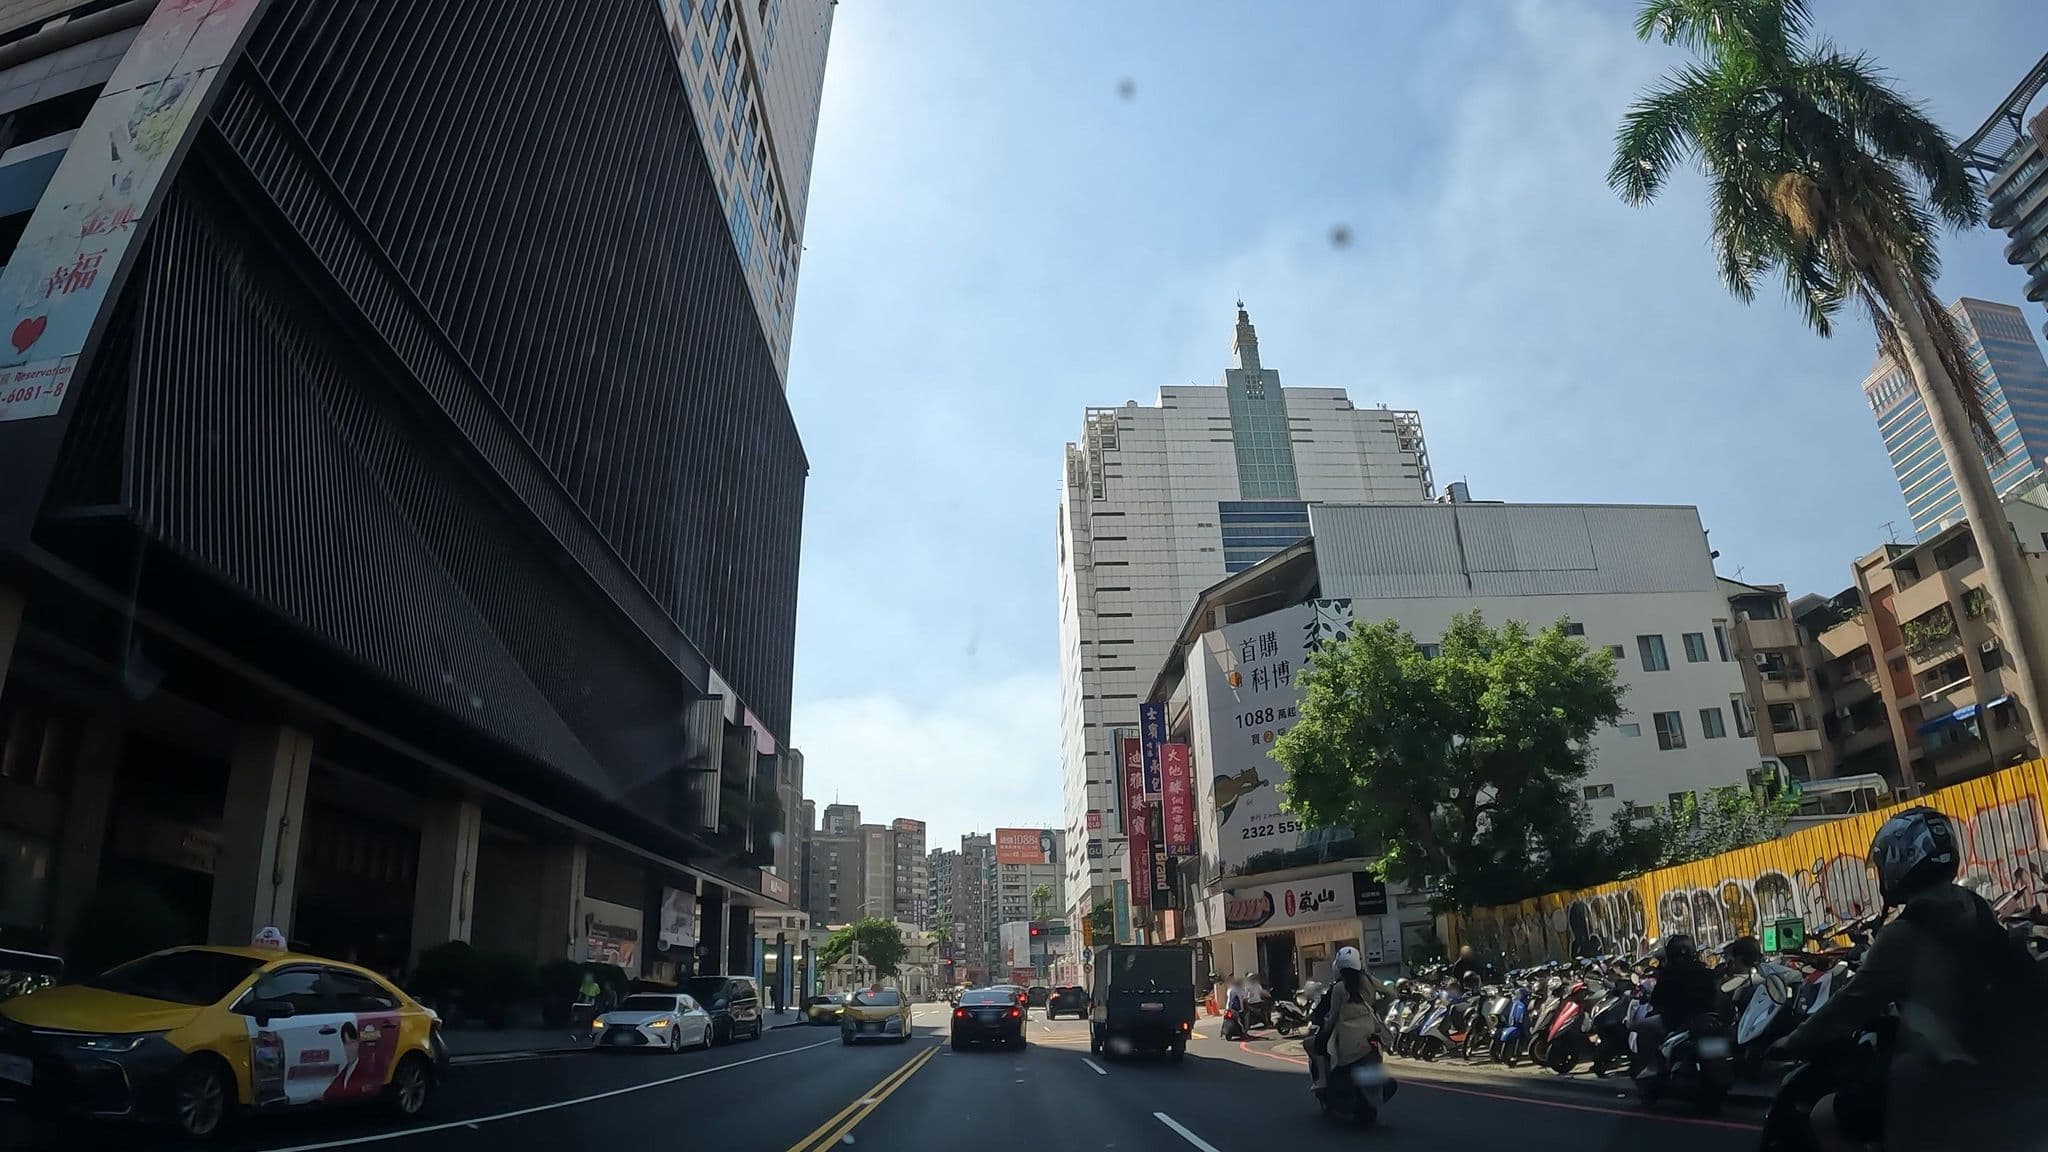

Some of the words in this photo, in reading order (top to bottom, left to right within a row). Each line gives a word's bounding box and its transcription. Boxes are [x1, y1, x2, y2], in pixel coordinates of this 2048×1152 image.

[14, 366, 71, 382] Reservation
[1239, 631, 1279, 664] 首購
[1251, 660, 1291, 693] 科博
[1235, 707, 1275, 729] 1088
[1242, 824, 1276, 840] 2322
[1278, 820, 1303, 834] 559
[1088, 848, 1102, 856] GU
[1171, 844, 1190, 856] 24H
[1155, 852, 1170, 891] Brand
